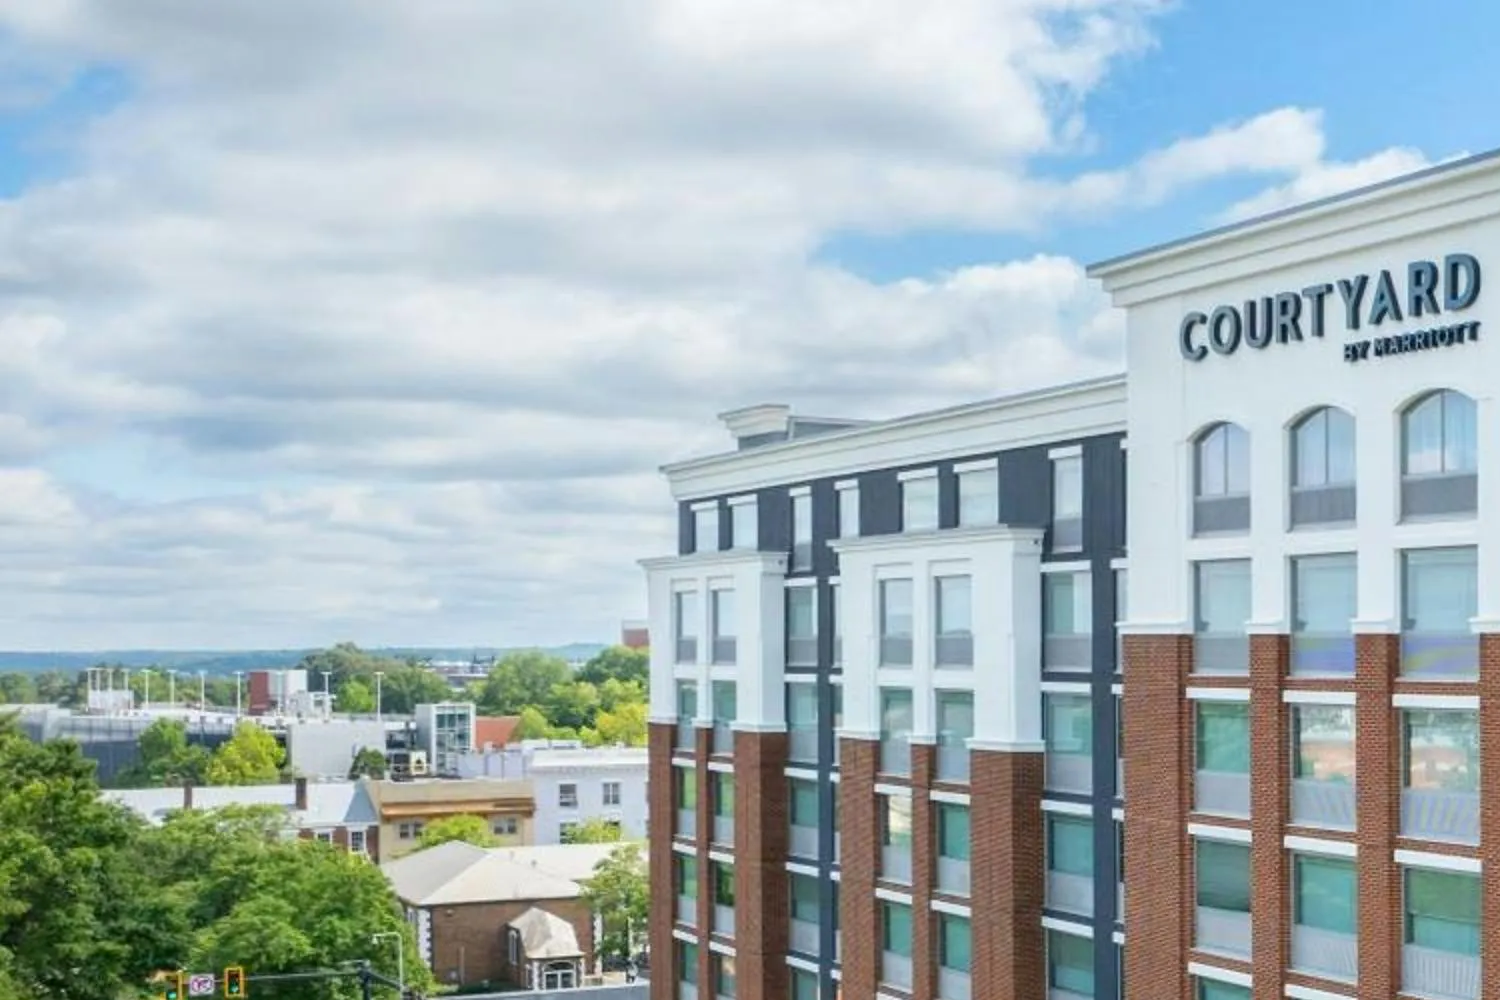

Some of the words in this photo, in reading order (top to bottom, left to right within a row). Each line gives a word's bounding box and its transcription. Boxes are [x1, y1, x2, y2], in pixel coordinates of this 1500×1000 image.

[1179, 253, 1482, 362] COURTYARD
[1344, 340, 1371, 362] BY
[1374, 321, 1481, 357] MARRIOTT
